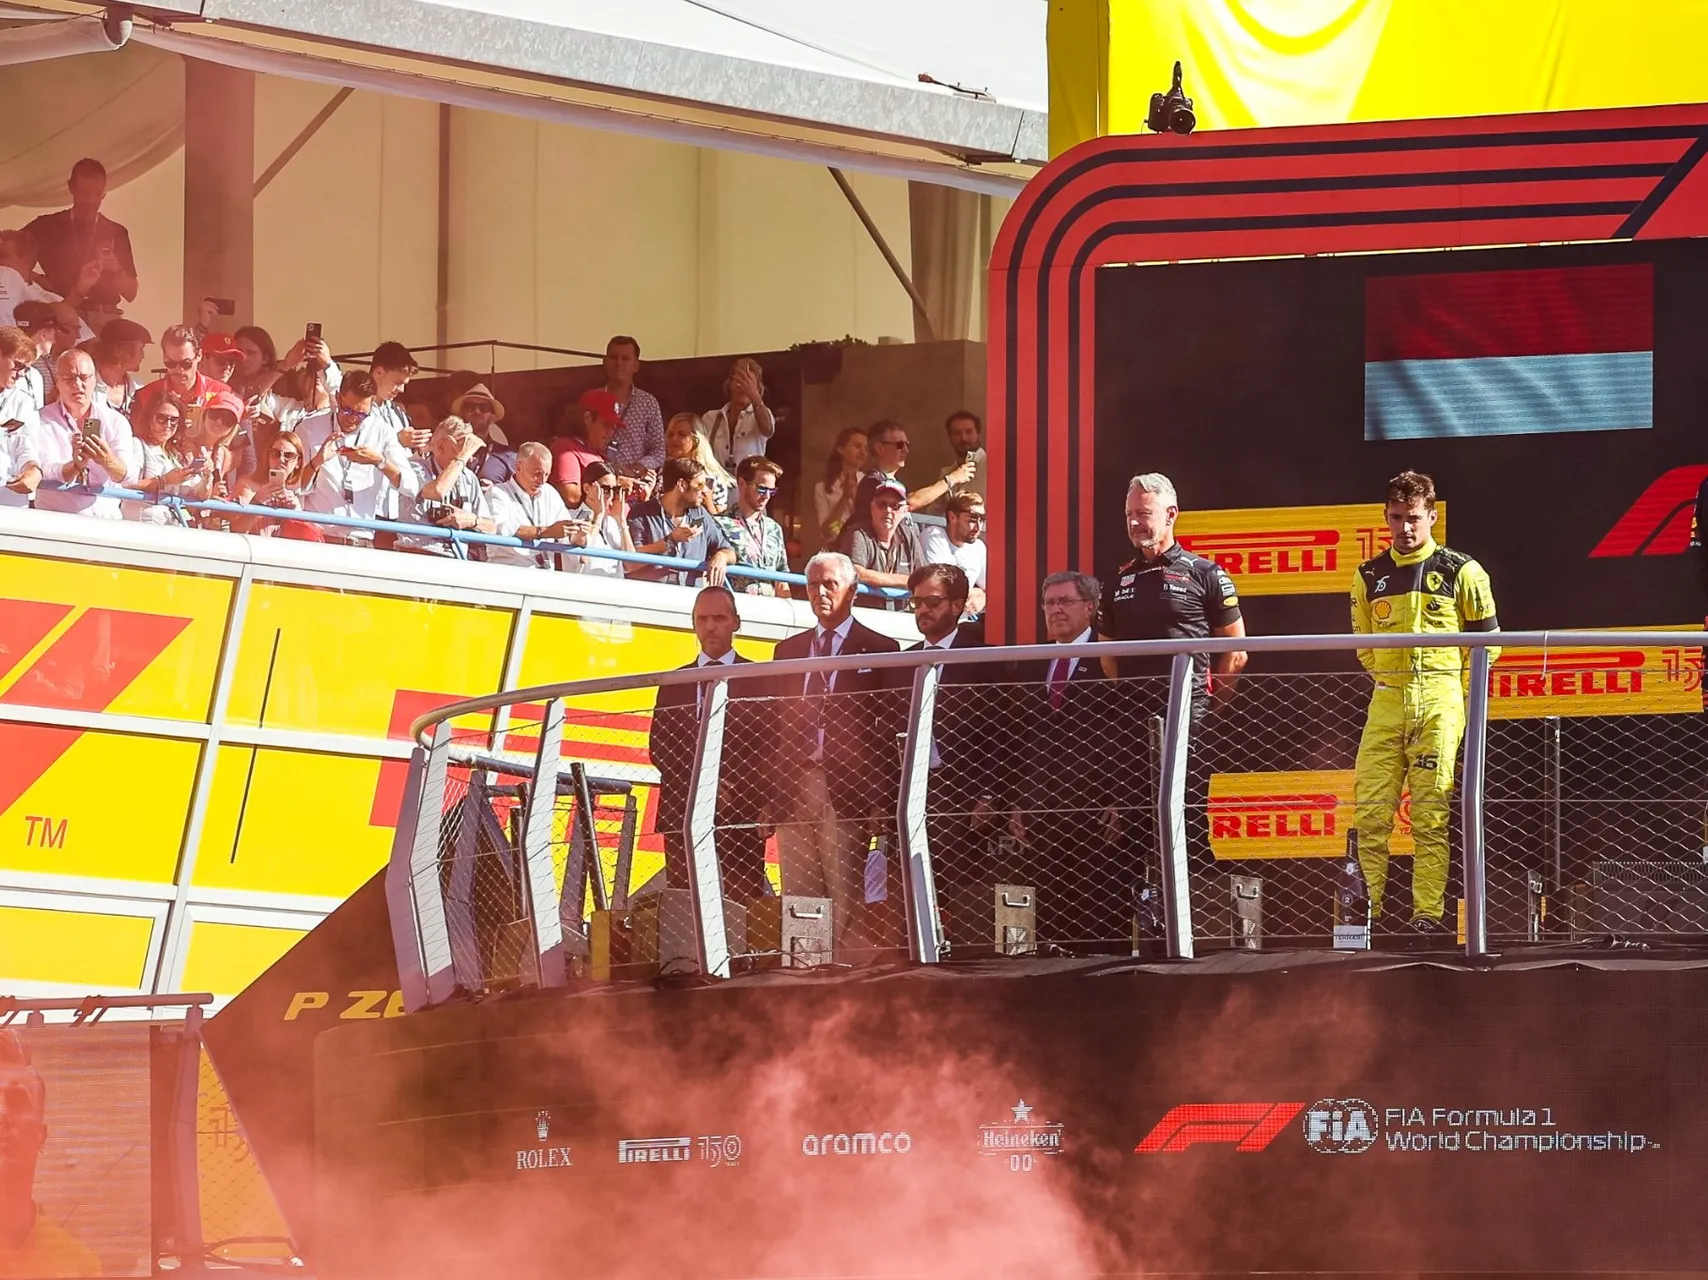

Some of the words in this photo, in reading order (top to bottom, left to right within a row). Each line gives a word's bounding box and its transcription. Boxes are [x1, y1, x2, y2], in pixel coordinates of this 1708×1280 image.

[25, 815, 68, 849] TM
[284, 991, 329, 1021] P
[1386, 1108, 1425, 1127] FIA
[1433, 1107, 1537, 1127] Formula
[1541, 1108, 1556, 1127] 1
[618, 1137, 691, 1164] PIRELLI
[802, 1132, 912, 1156] aramco
[982, 1129, 1061, 1148] Heineken
[1386, 1131, 1461, 1152] World
[1464, 1130, 1645, 1154] Championship
[516, 1147, 573, 1171] ROLEX
